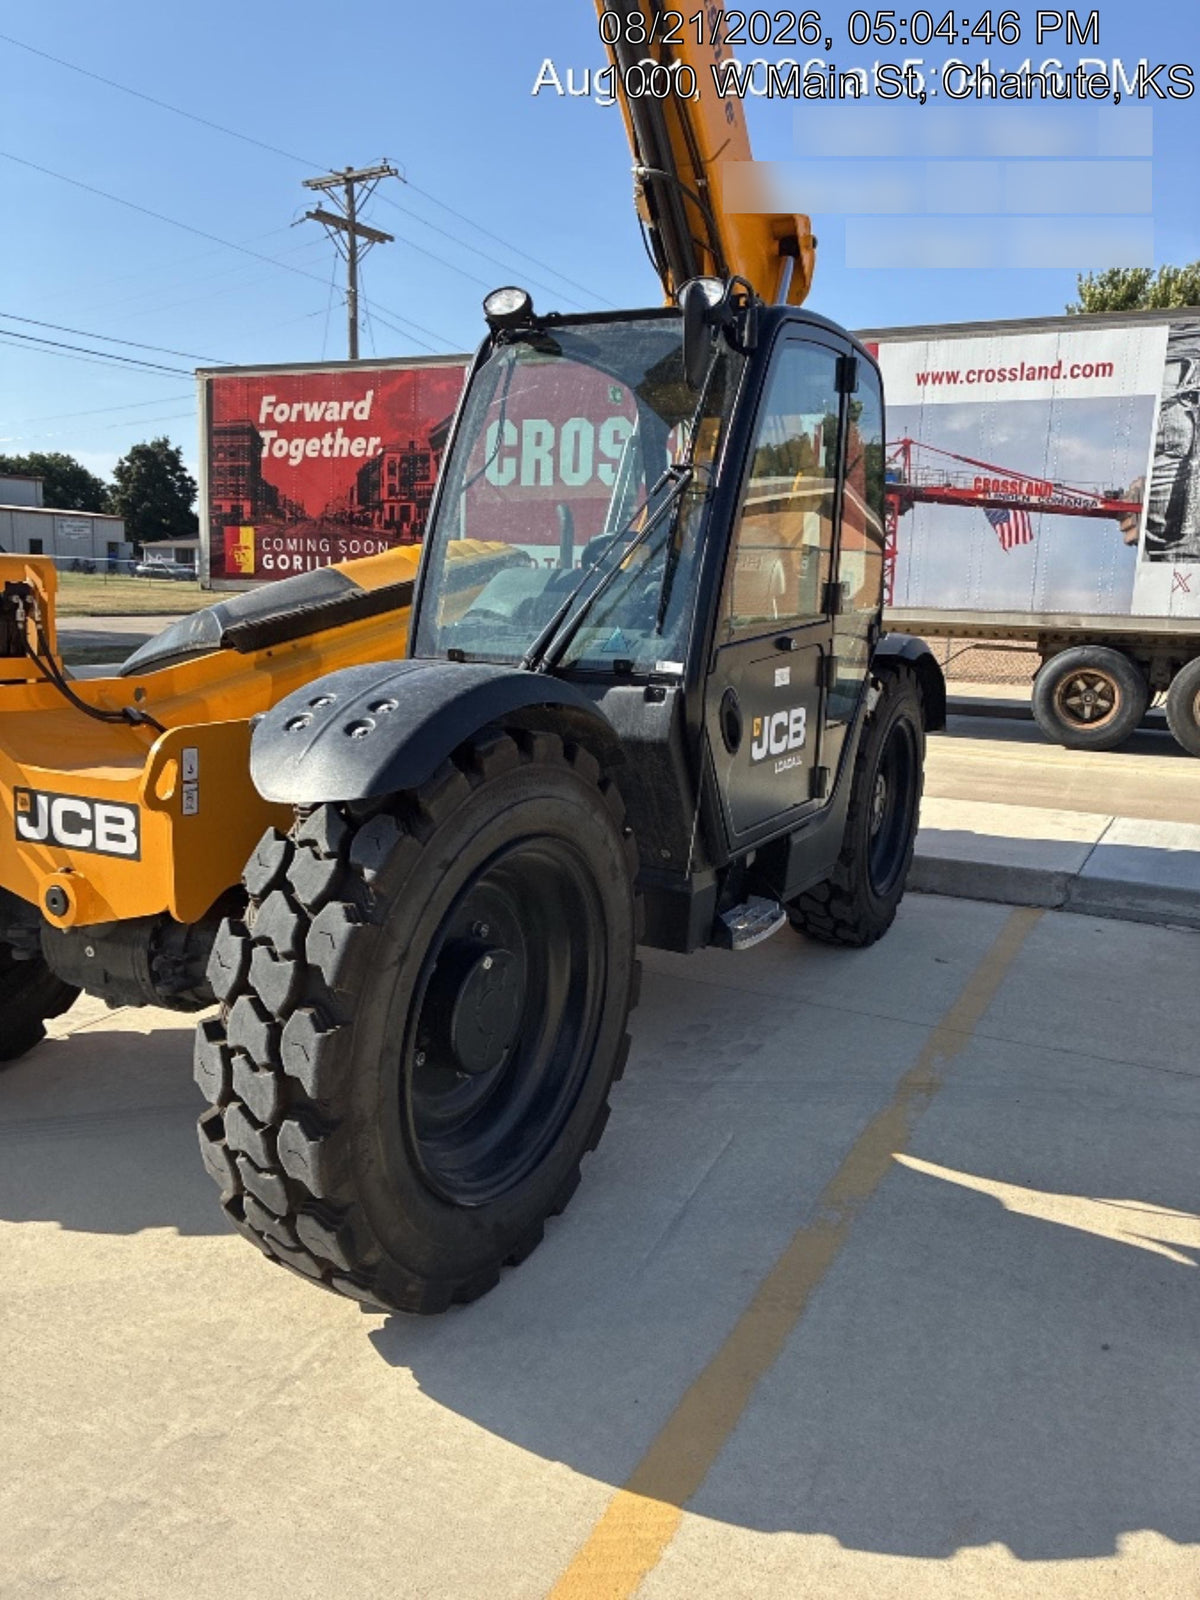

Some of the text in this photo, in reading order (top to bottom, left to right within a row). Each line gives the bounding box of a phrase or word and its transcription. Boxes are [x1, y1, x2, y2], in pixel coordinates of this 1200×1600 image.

[916, 359, 1114, 386] www.crossland.com
[258, 389, 373, 424] Forward
[973, 476, 1053, 498] CROSSLAND
[262, 537, 388, 554] COMING SOON
[751, 706, 807, 761] JCB
[16, 793, 139, 856] JCB
